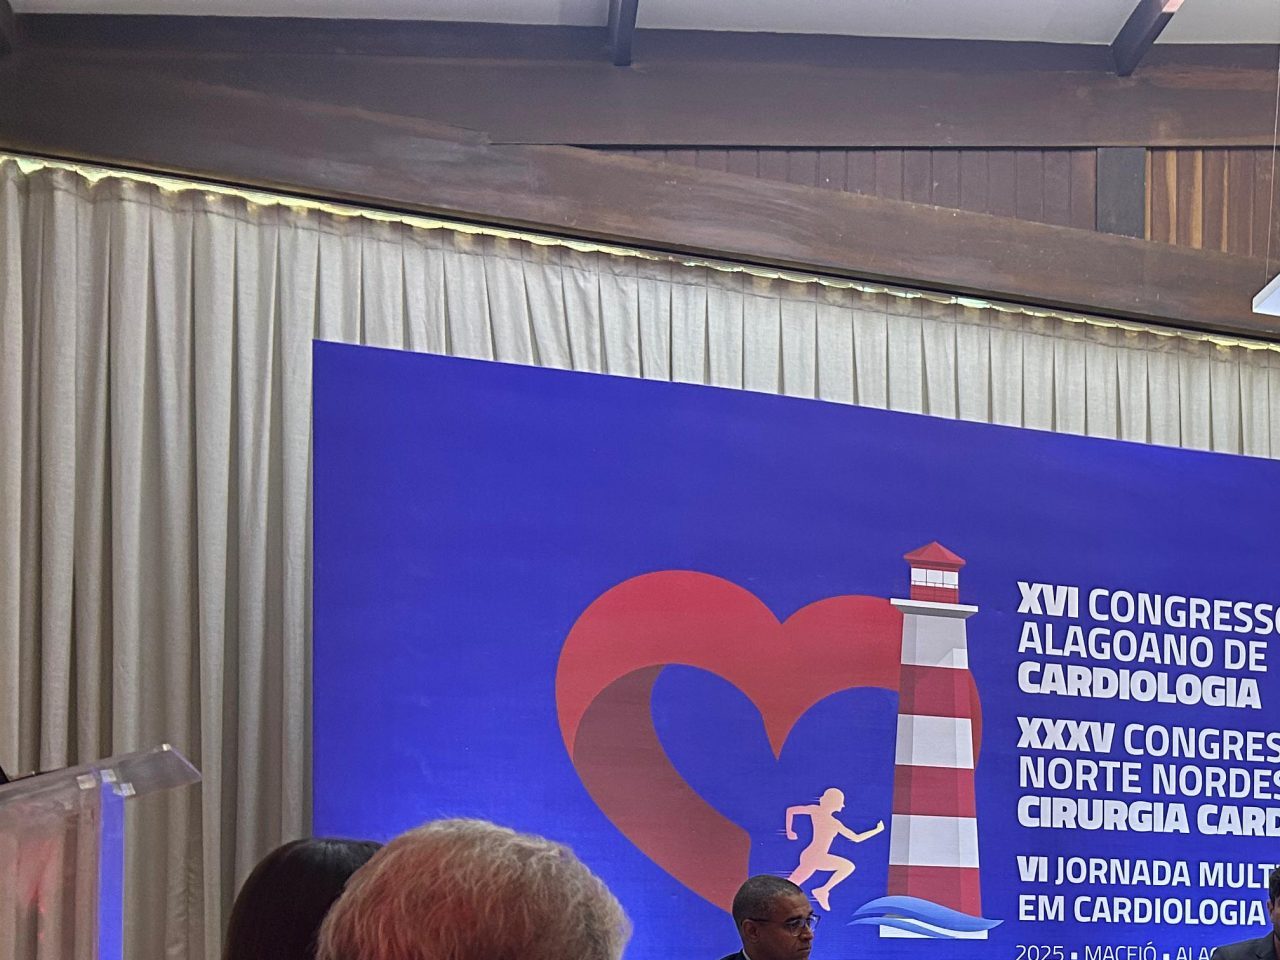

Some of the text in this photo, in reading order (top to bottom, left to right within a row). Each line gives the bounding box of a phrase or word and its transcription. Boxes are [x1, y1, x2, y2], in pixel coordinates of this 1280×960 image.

[1017, 581, 1079, 618] XVI
[1018, 621, 1268, 672] ALAGOANO DE
[1018, 661, 1262, 709] CARDIOLOGIA
[1016, 716, 1116, 753] XXXV
[1019, 756, 1142, 794] NORTE
[1017, 796, 1190, 834] CIRURGIA
[1016, 855, 1048, 883] VI
[1055, 857, 1191, 887] JORNADA
[1019, 894, 1266, 926] EM CARDIOLOGIA
